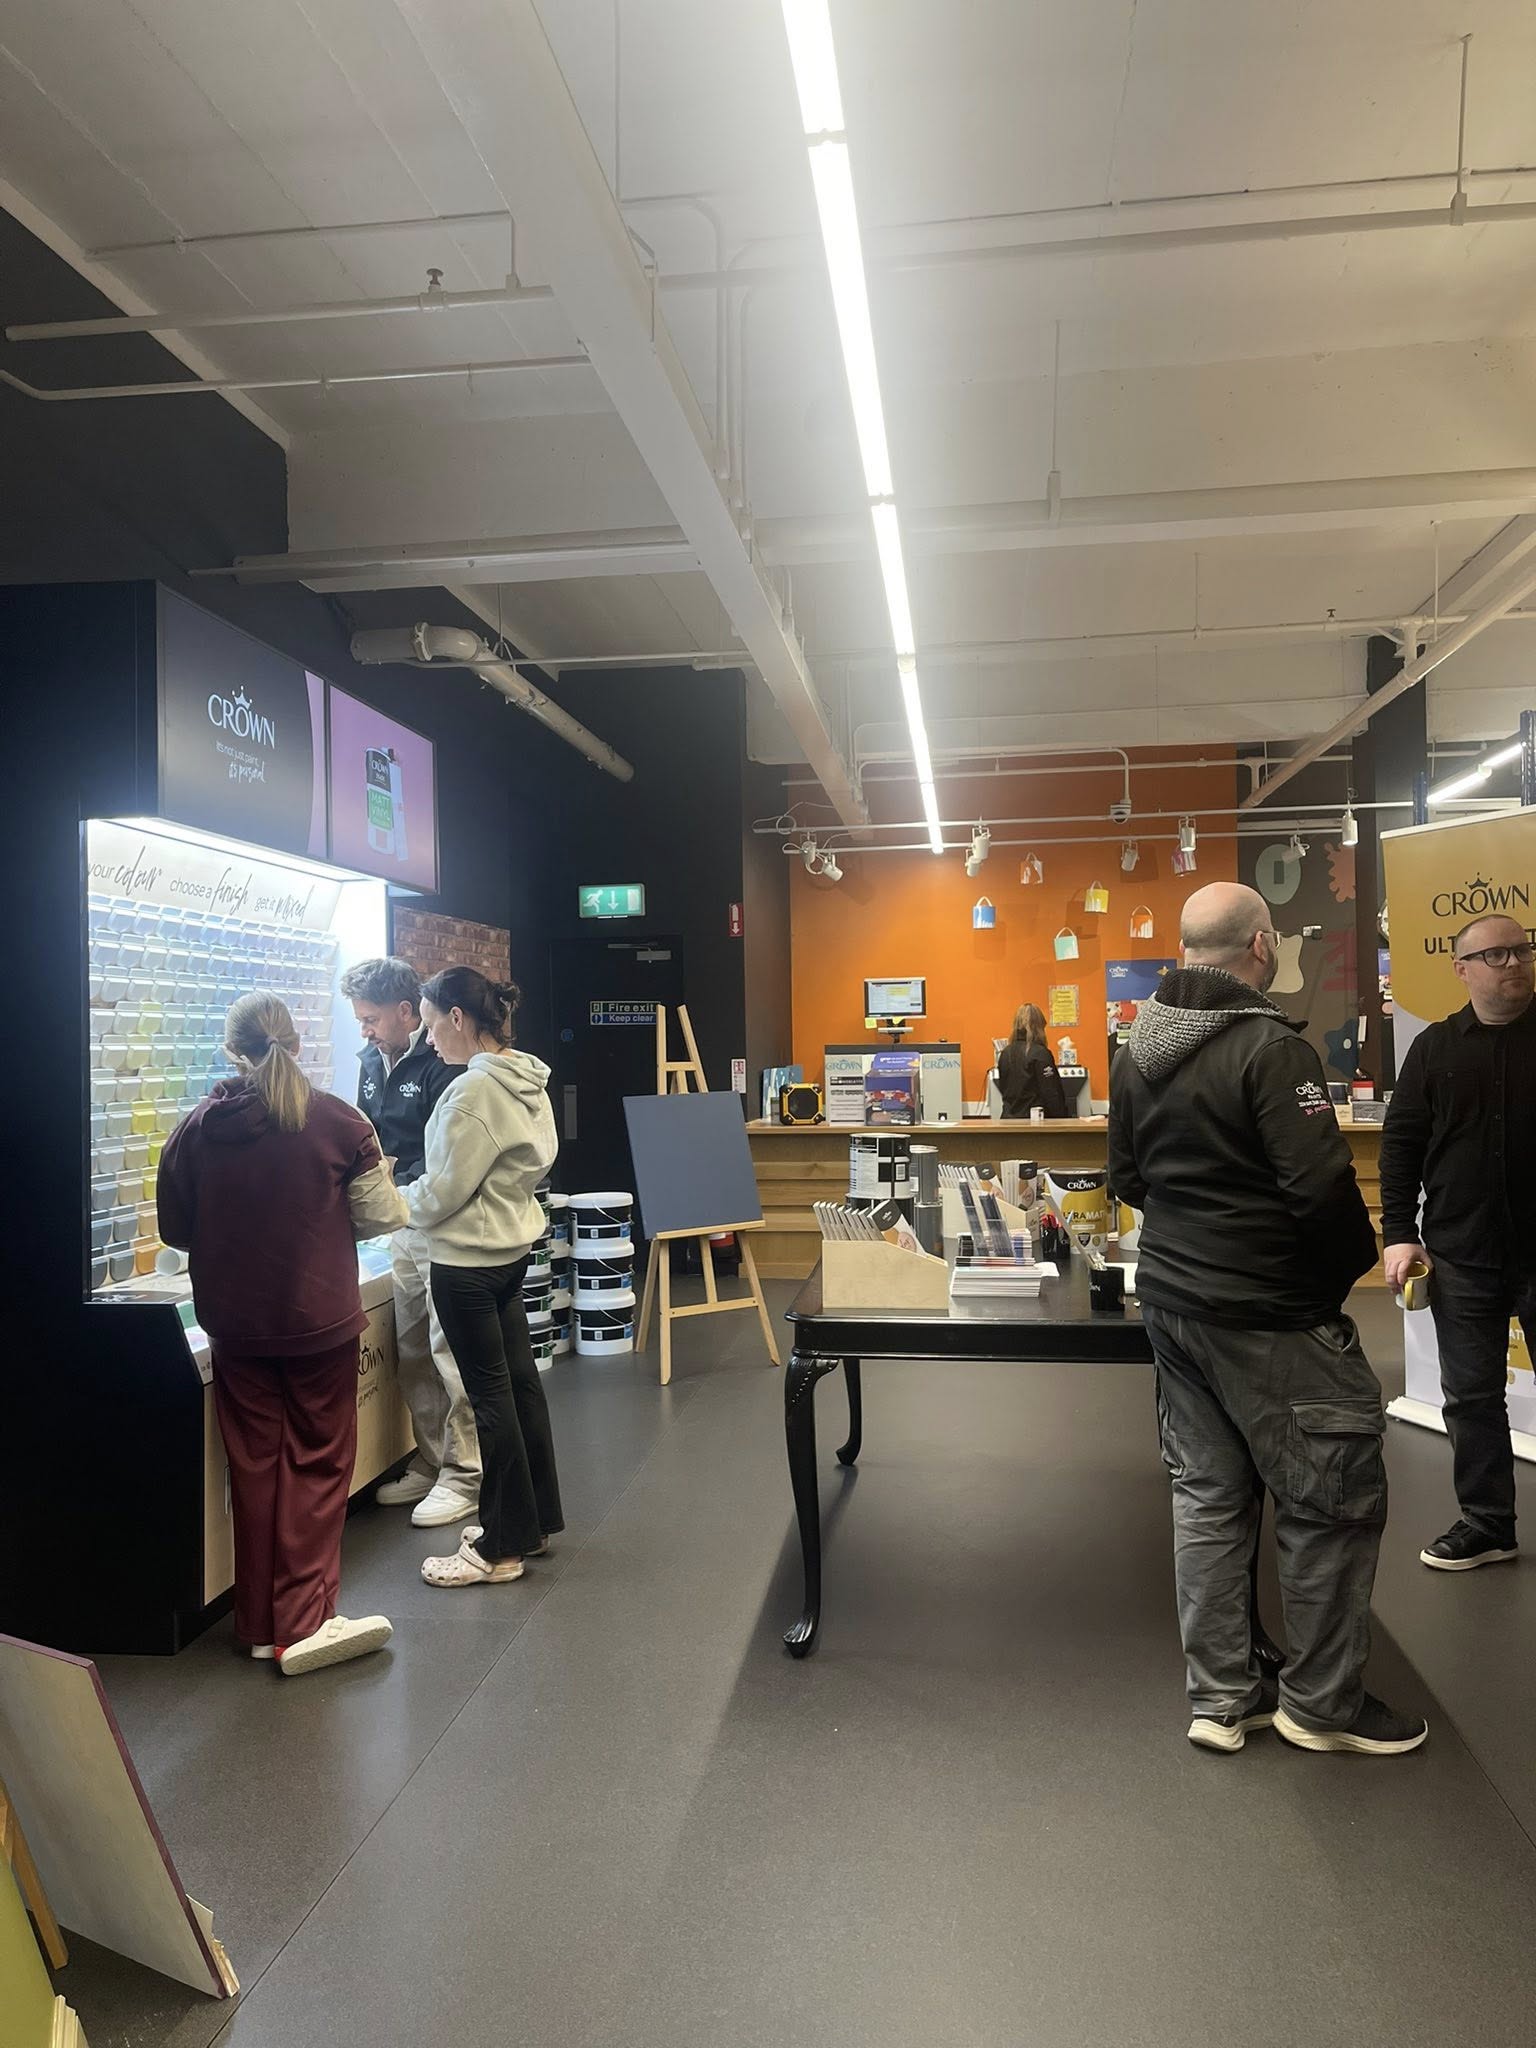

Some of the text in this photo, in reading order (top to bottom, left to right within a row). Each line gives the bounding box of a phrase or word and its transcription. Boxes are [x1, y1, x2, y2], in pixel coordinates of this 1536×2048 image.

[207, 693, 275, 750] CROWN
[169, 877, 206, 898] choose
[208, 867, 252, 916] finish
[274, 884, 315, 924] mixed
[1432, 884, 1530, 917] CROWN
[608, 1003, 654, 1012] Fire exit
[609, 1014, 653, 1023] Keep clear
[922, 1060, 960, 1069] CROWN
[1067, 1181, 1097, 1190] CROWN
